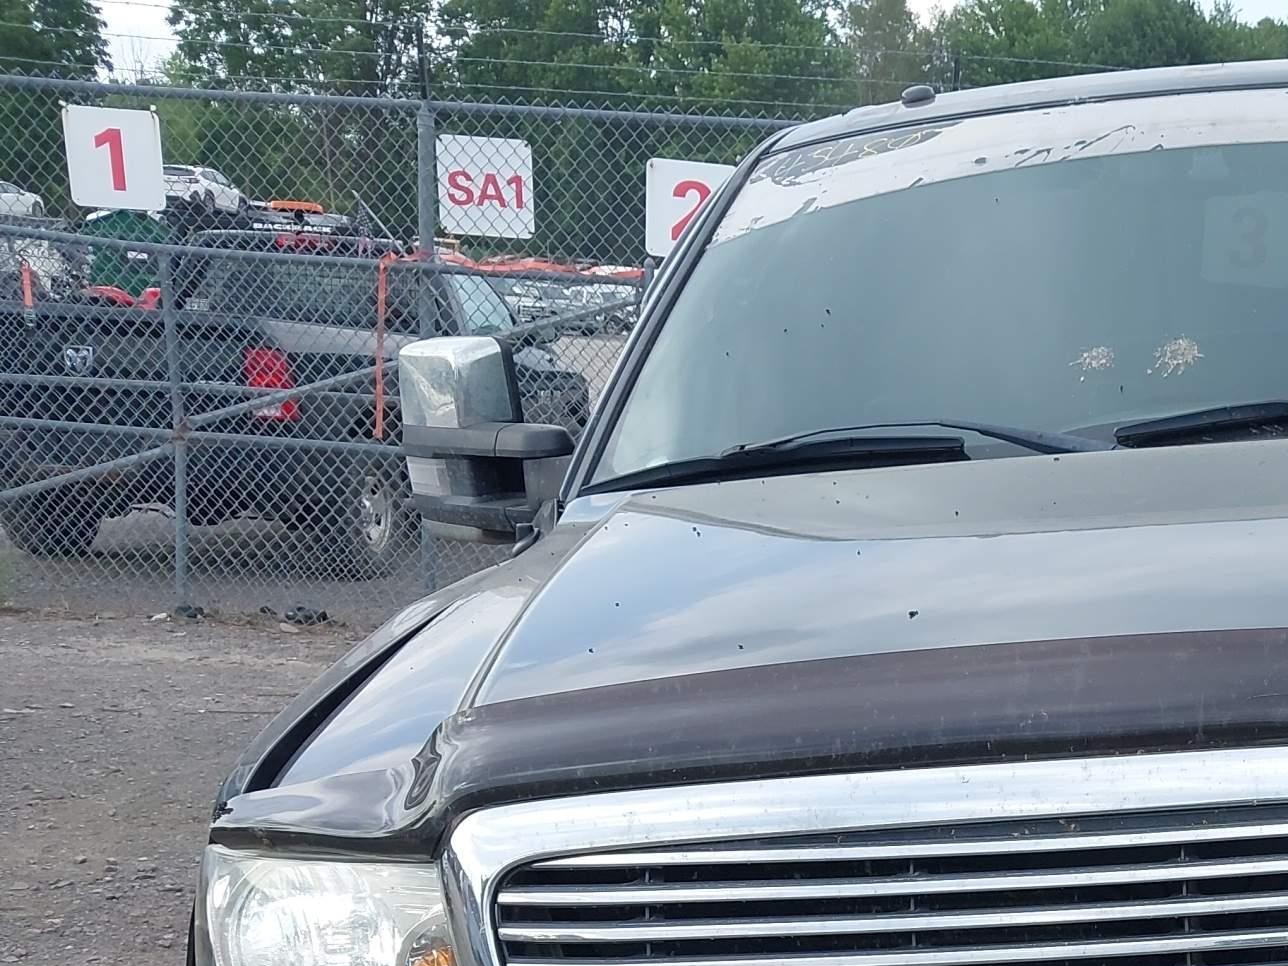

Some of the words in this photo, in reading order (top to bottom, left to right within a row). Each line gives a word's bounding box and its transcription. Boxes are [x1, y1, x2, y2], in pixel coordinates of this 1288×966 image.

[94, 127, 127, 192] 1
[447, 170, 526, 209] SA1
[671, 180, 712, 241] 2
[1229, 207, 1267, 269] 3
